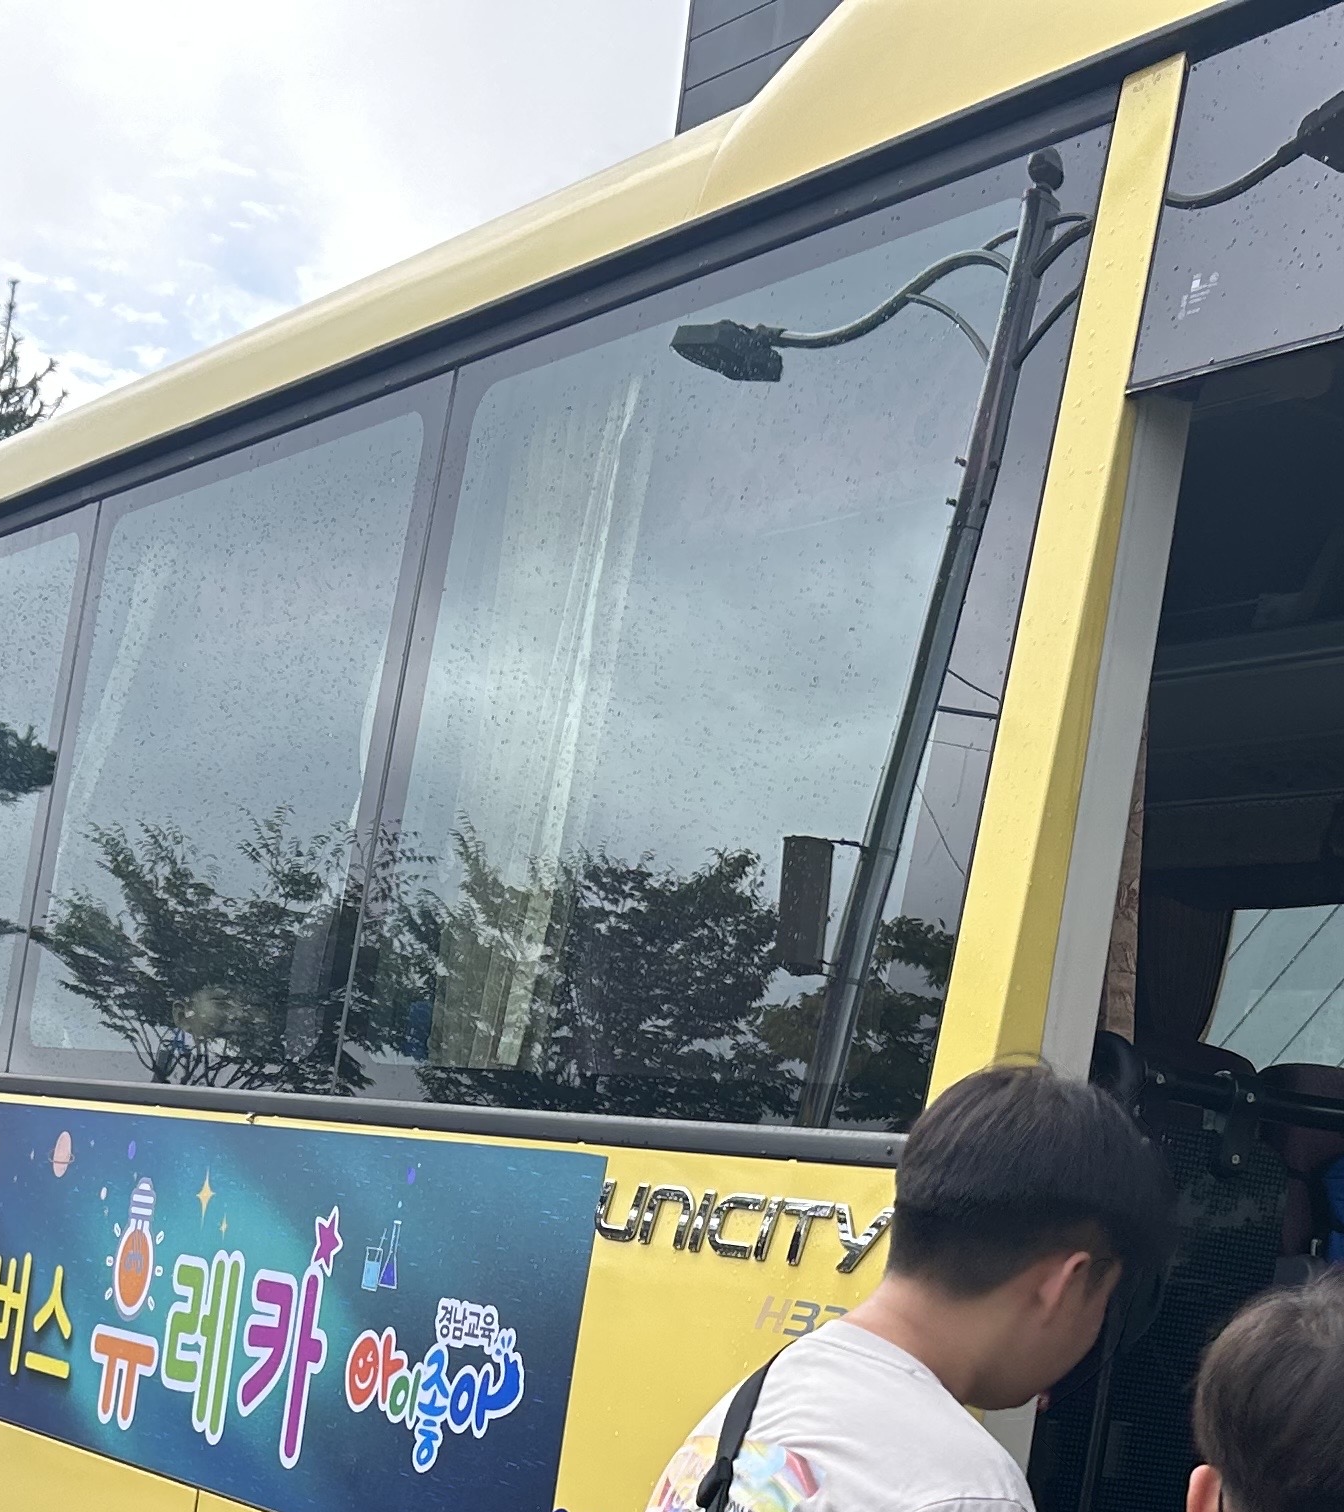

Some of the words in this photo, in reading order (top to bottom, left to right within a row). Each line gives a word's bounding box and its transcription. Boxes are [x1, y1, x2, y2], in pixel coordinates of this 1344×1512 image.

[595, 1178, 896, 1273] UNICITY
[91, 1178, 342, 1469] 유레카
[436, 1301, 498, 1350] 경남교육
[346, 1328, 524, 1472] 아이좋아
